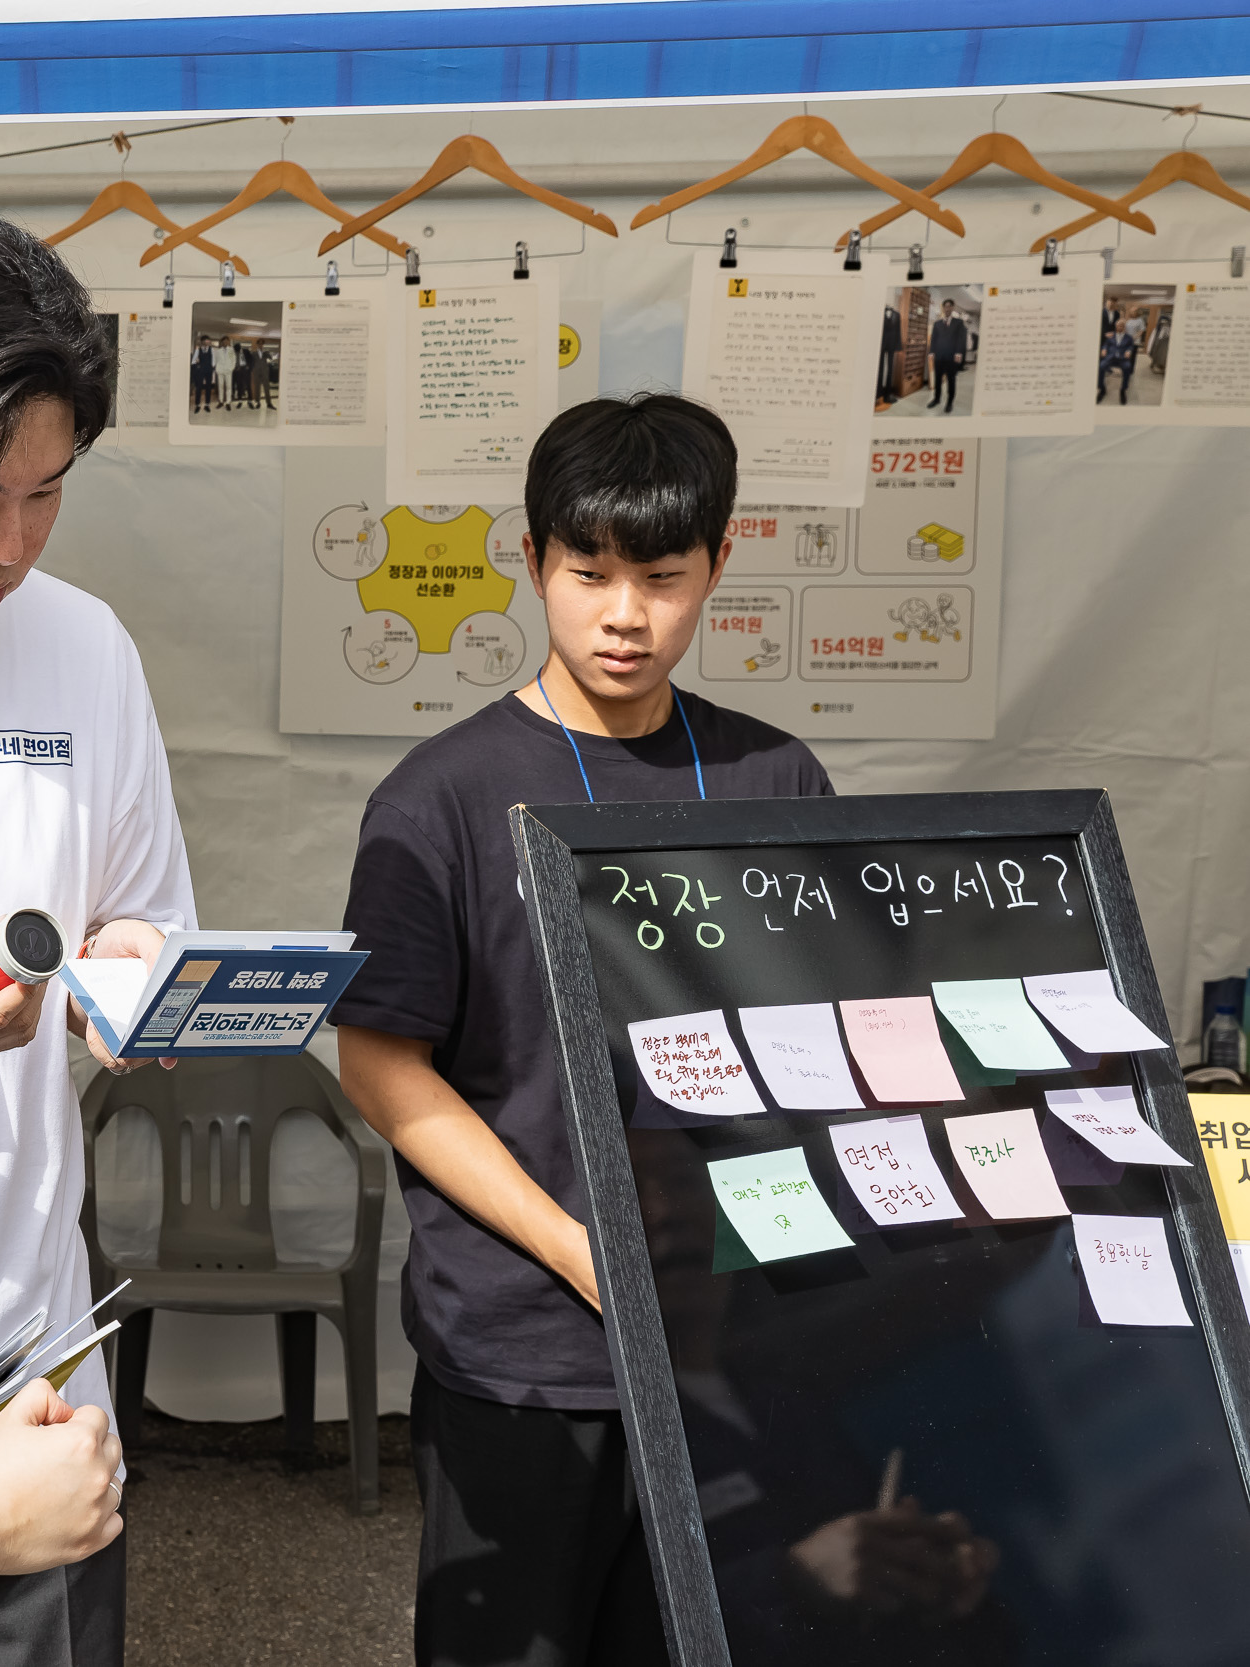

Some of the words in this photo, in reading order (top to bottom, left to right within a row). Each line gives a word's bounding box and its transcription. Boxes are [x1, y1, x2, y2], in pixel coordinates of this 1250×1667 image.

[871, 451, 964, 474] 572억원
[388, 565, 428, 580] 정장과
[432, 565, 485, 580] 이야기의
[416, 582, 456, 598] 선순환
[710, 616, 763, 634] 14억원
[810, 637, 884, 657] 154억원
[23, 737, 70, 758] 편의점
[601, 866, 725, 950] 정장
[742, 868, 837, 932] 언제
[861, 854, 1074, 927] 입으세요?
[286, 971, 328, 989] 정책
[189, 1011, 256, 1032] 편의점
[251, 1011, 313, 1032] 진구네
[844, 1141, 911, 1171] 면접,
[965, 1138, 1015, 1166] 경조사
[870, 1180, 935, 1215] 음악회
[1094, 1239, 1131, 1263] 중요한
[1134, 1245, 1152, 1270] 날
